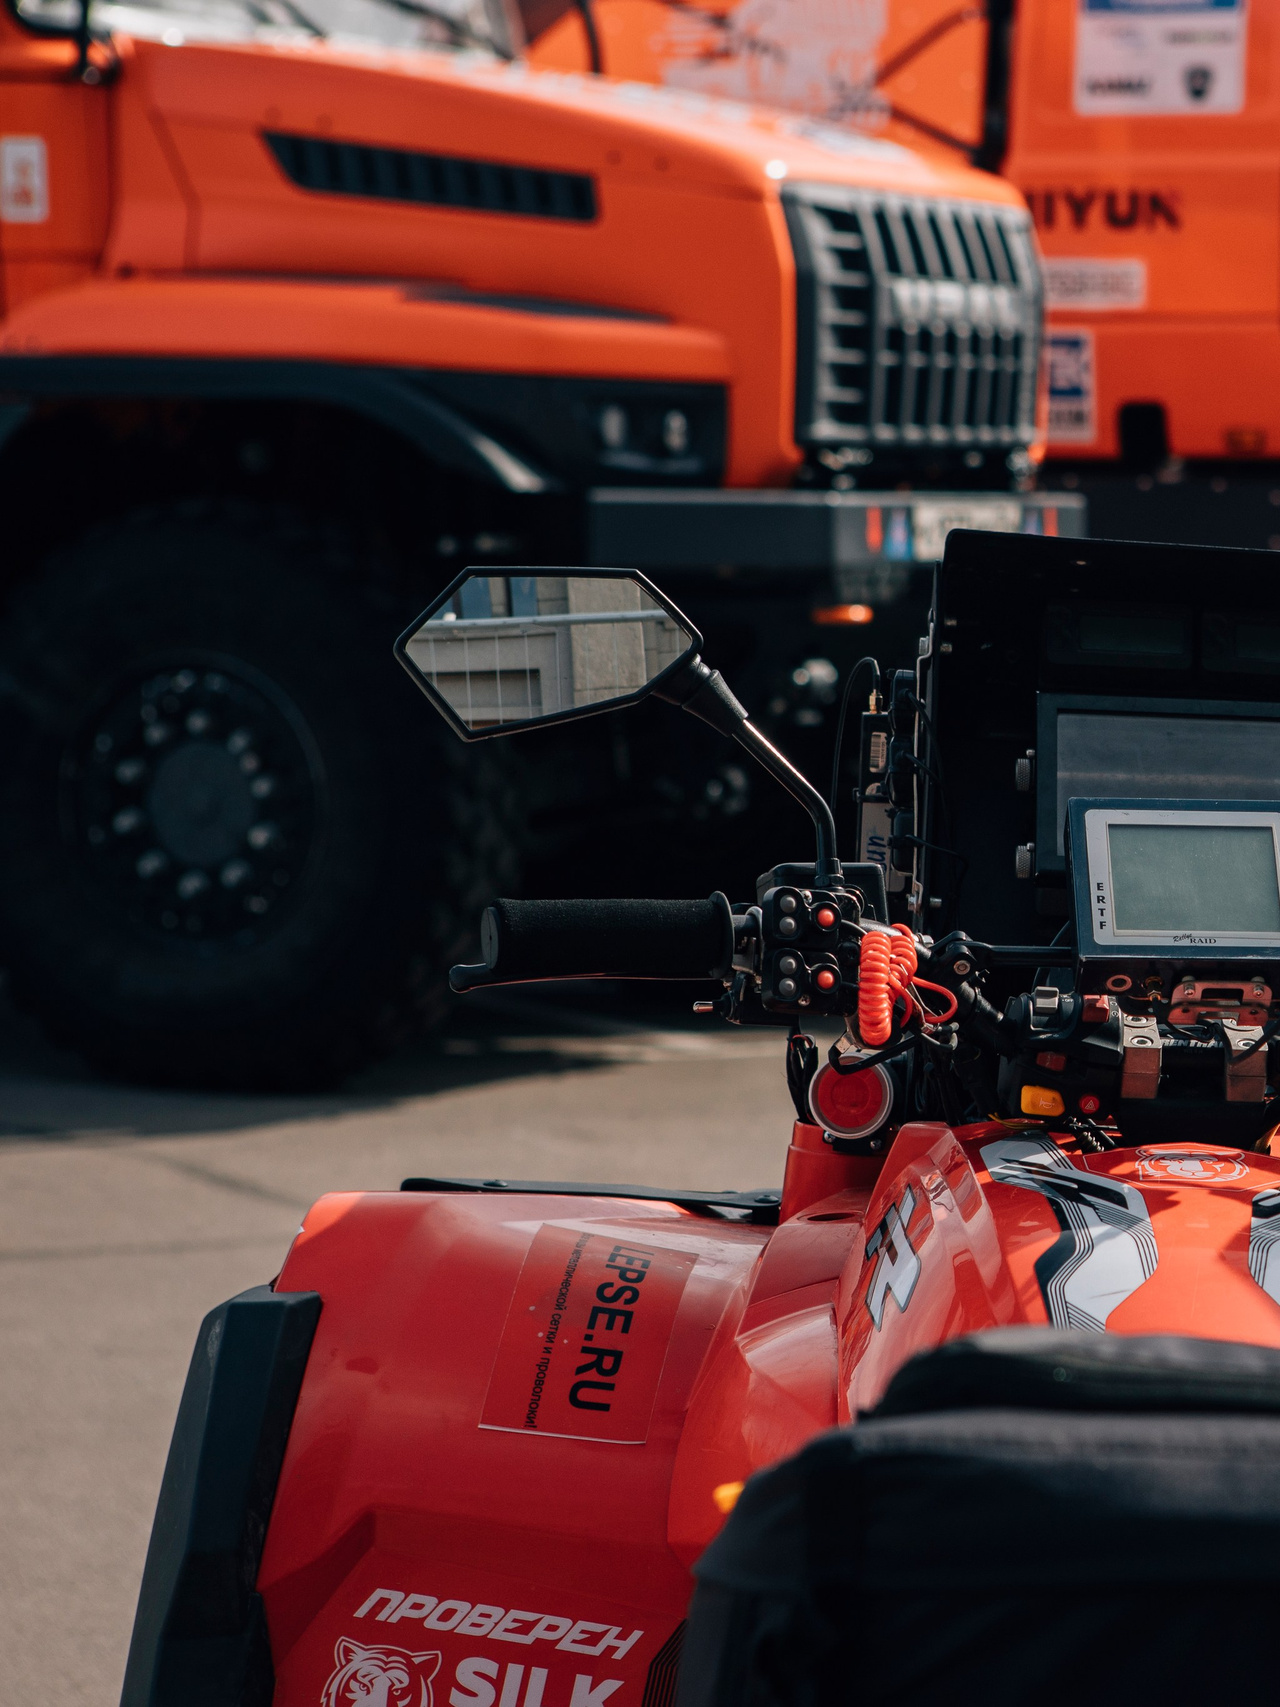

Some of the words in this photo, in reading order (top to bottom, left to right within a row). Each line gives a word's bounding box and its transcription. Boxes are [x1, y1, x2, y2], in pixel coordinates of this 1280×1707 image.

[1096, 882, 1107, 930] ERTF
[1189, 937, 1217, 945] RAID
[542, 1346, 555, 1354] и
[545, 1313, 562, 1343] сетки
[568, 1245, 655, 1412] LEPSE.RU
[524, 1357, 551, 1430] проволоки!
[353, 1587, 645, 1660] ПРОВЕРЕН
